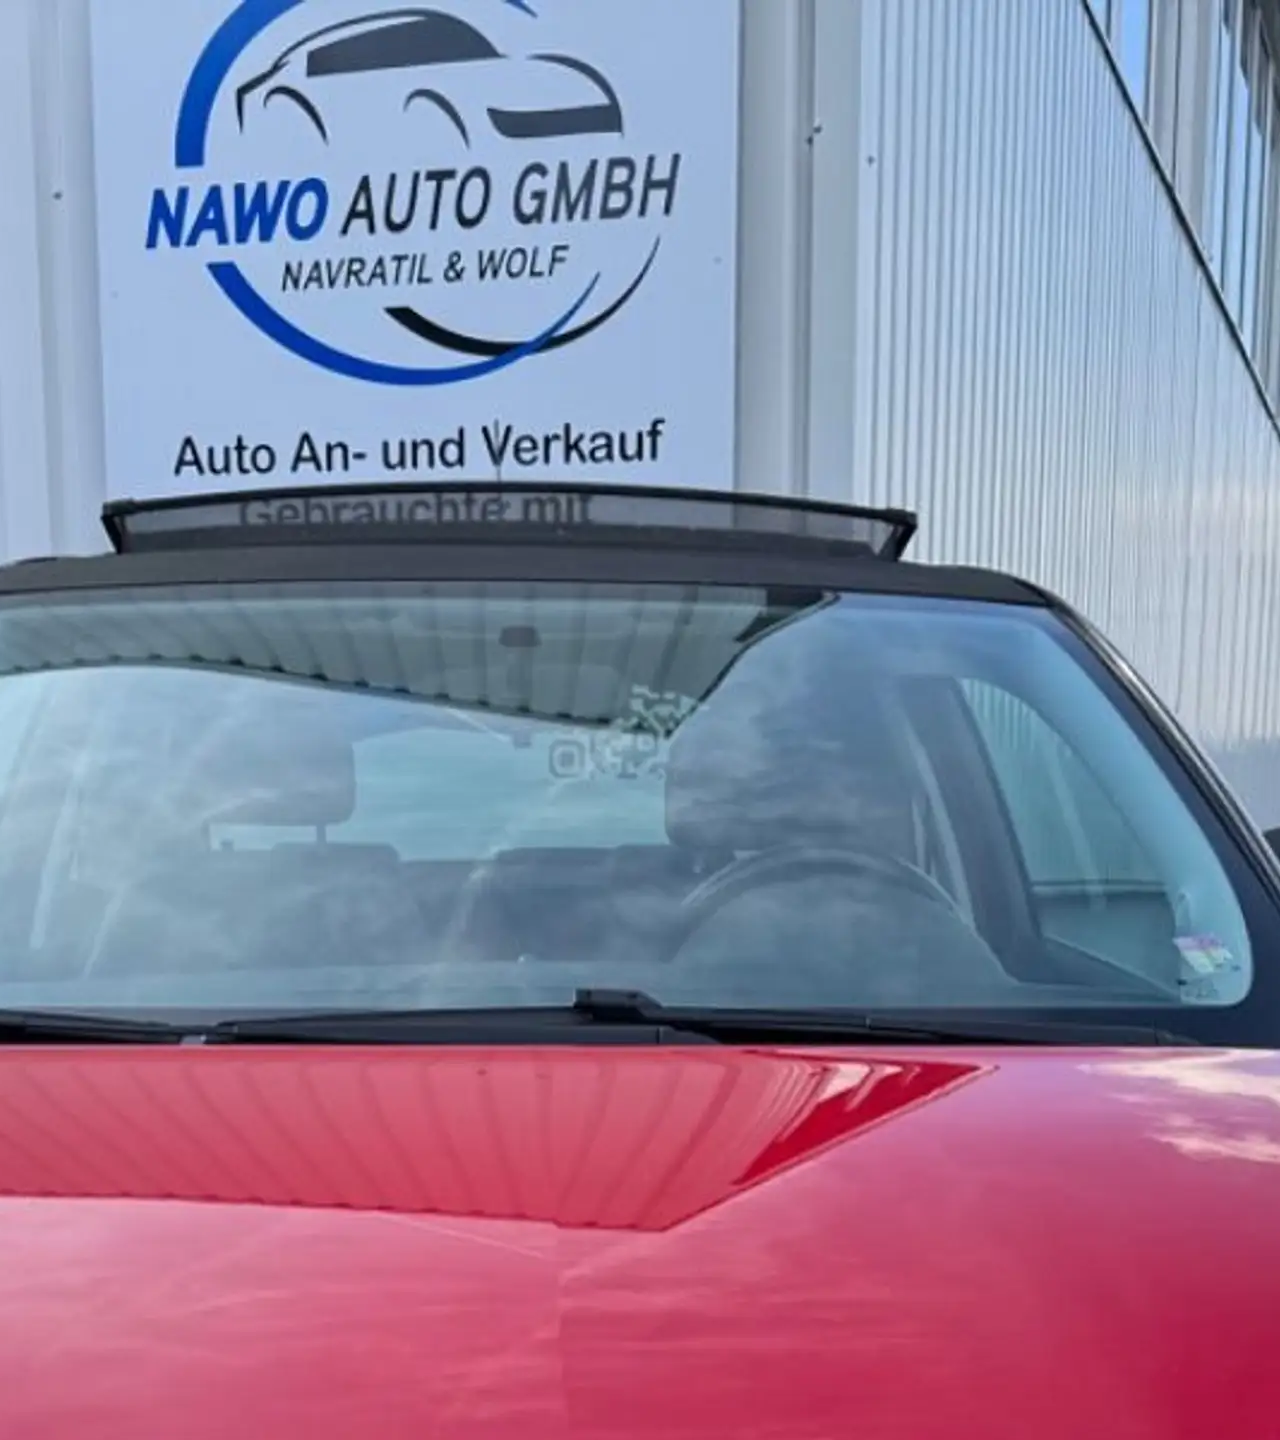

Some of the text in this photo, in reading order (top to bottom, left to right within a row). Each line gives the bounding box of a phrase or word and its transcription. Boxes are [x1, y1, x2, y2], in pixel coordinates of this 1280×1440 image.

[145, 153, 681, 249] NAWO AUTO GMBH
[281, 244, 569, 292] NAVRATIL & WOLF
[174, 418, 666, 476] Auto An- und Verkauf
[239, 493, 507, 525] Gebrauchte
